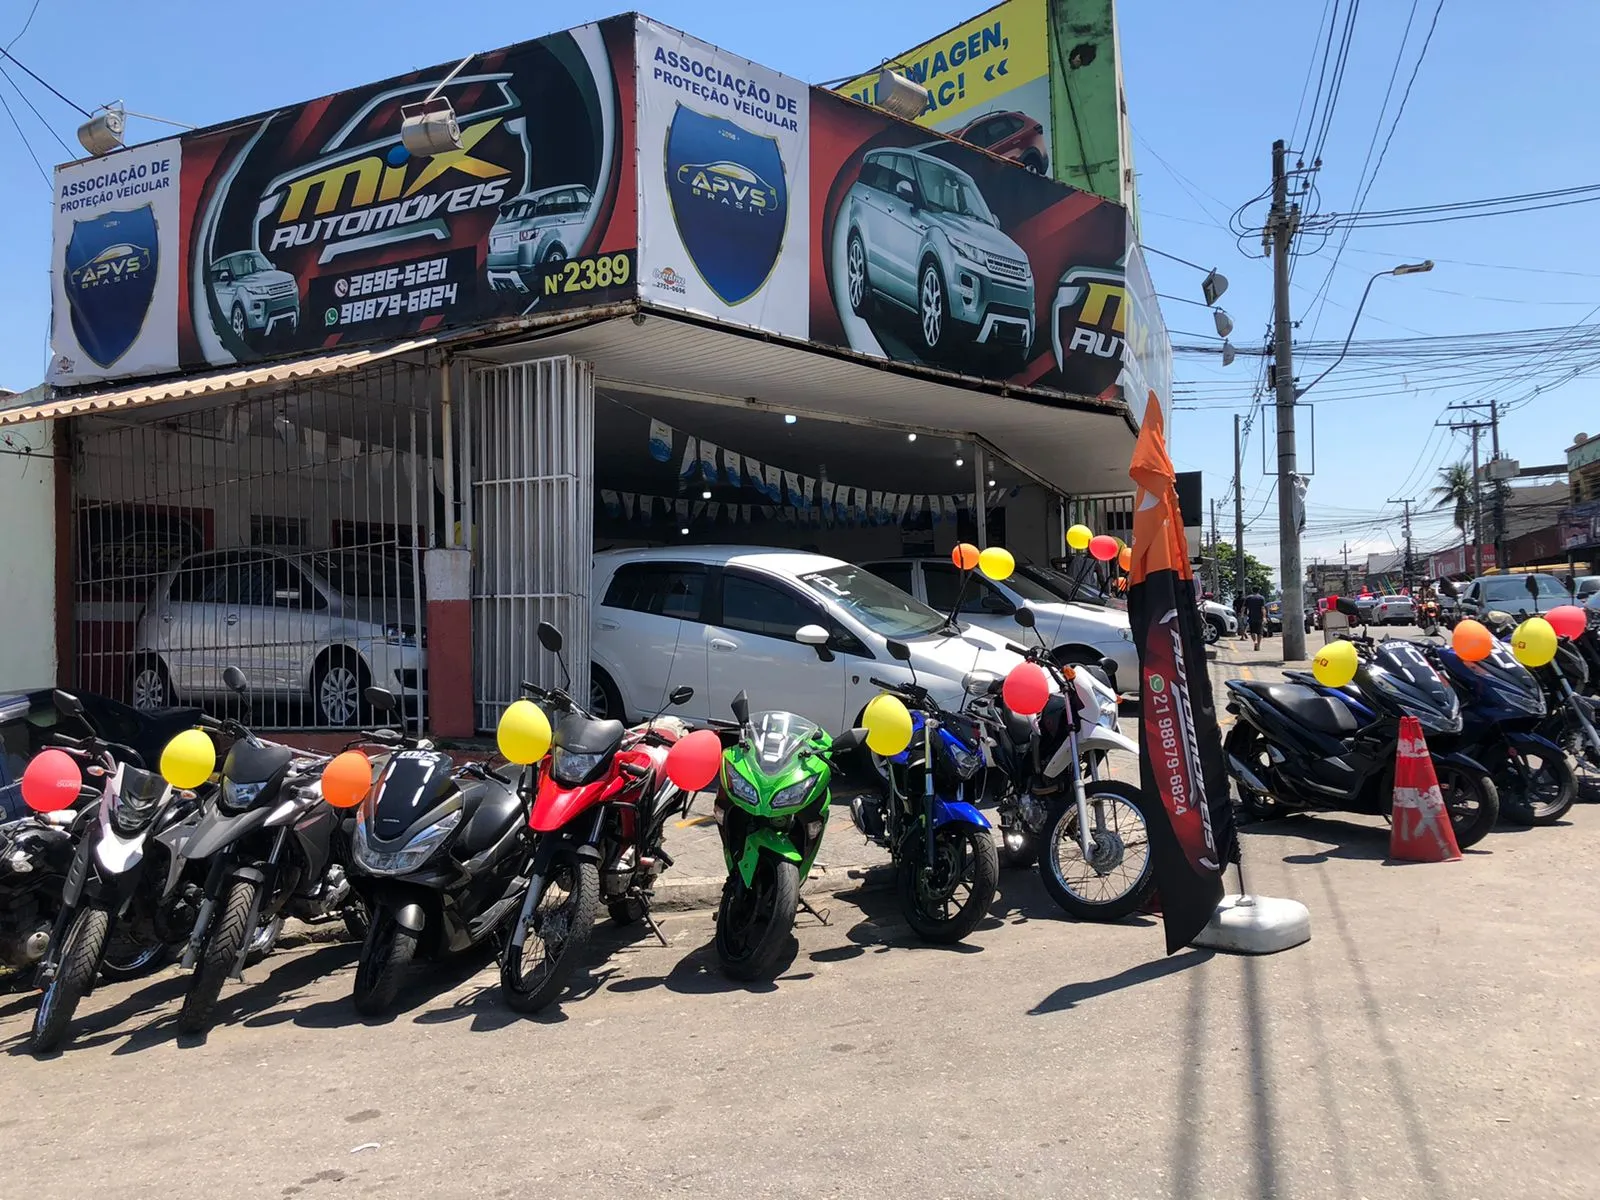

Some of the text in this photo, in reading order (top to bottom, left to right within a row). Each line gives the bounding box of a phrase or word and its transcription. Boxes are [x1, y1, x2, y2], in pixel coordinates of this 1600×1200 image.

[654, 46, 798, 115] ASSOCIAÇÃO DE
[654, 68, 798, 132] PROTEÇÃO VEÍCULAR
[60, 177, 170, 213] PROTEÇÃO VEÍCULAR
[61, 159, 170, 198] ASSOCIAÇÃO DE
[691, 171, 767, 208] APVS
[692, 188, 765, 217] BRASIL
[81, 256, 141, 283] APVS
[82, 273, 140, 289] BRASIL
[349, 257, 448, 297] 2696-5221
[340, 283, 458, 325] 98879-6824
[1153, 694, 1188, 816] 21 98879-6824
